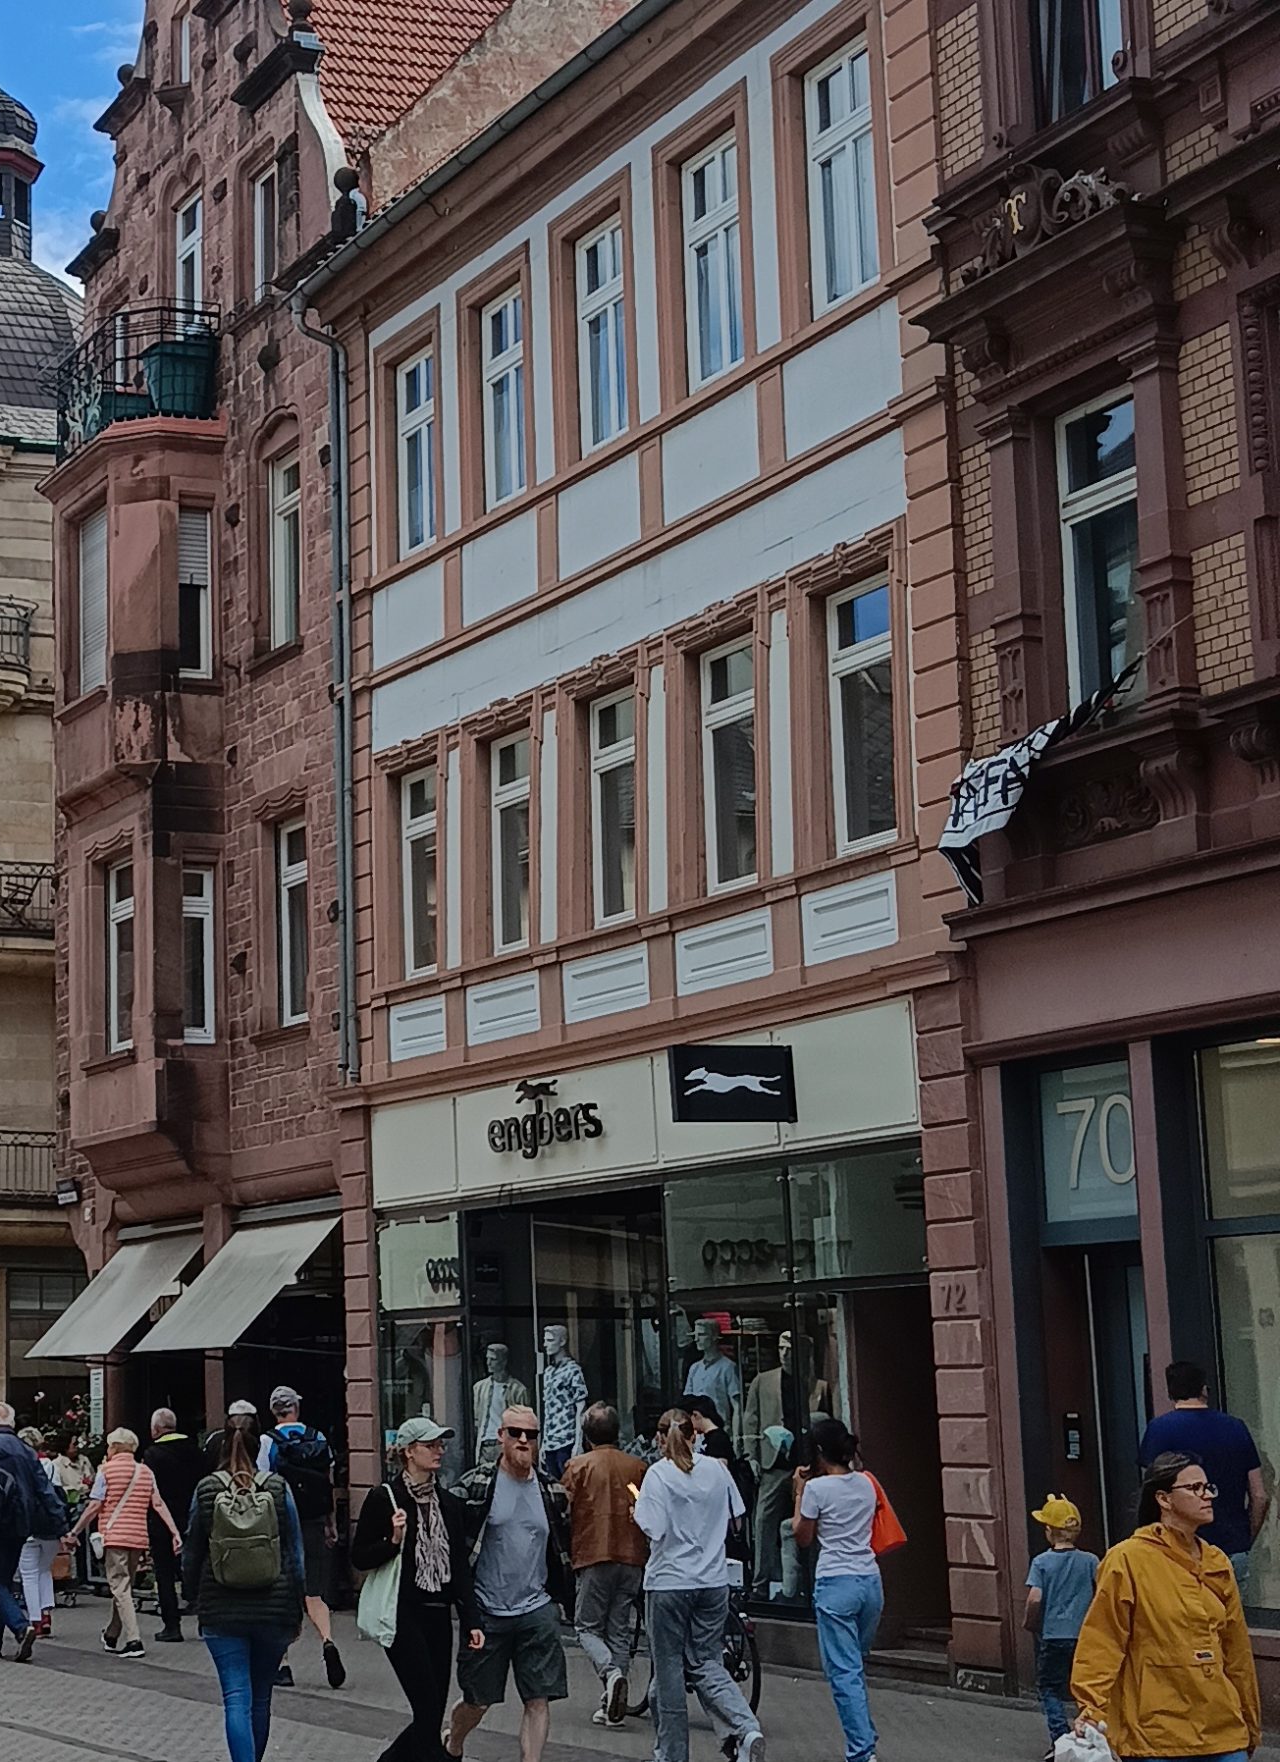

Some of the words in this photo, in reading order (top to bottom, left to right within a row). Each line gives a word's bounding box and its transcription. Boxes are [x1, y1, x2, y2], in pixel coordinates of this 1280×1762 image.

[487, 1098, 604, 1160] engbers
[1056, 1092, 1137, 1190] 70
[940, 1283, 968, 1314] 72
